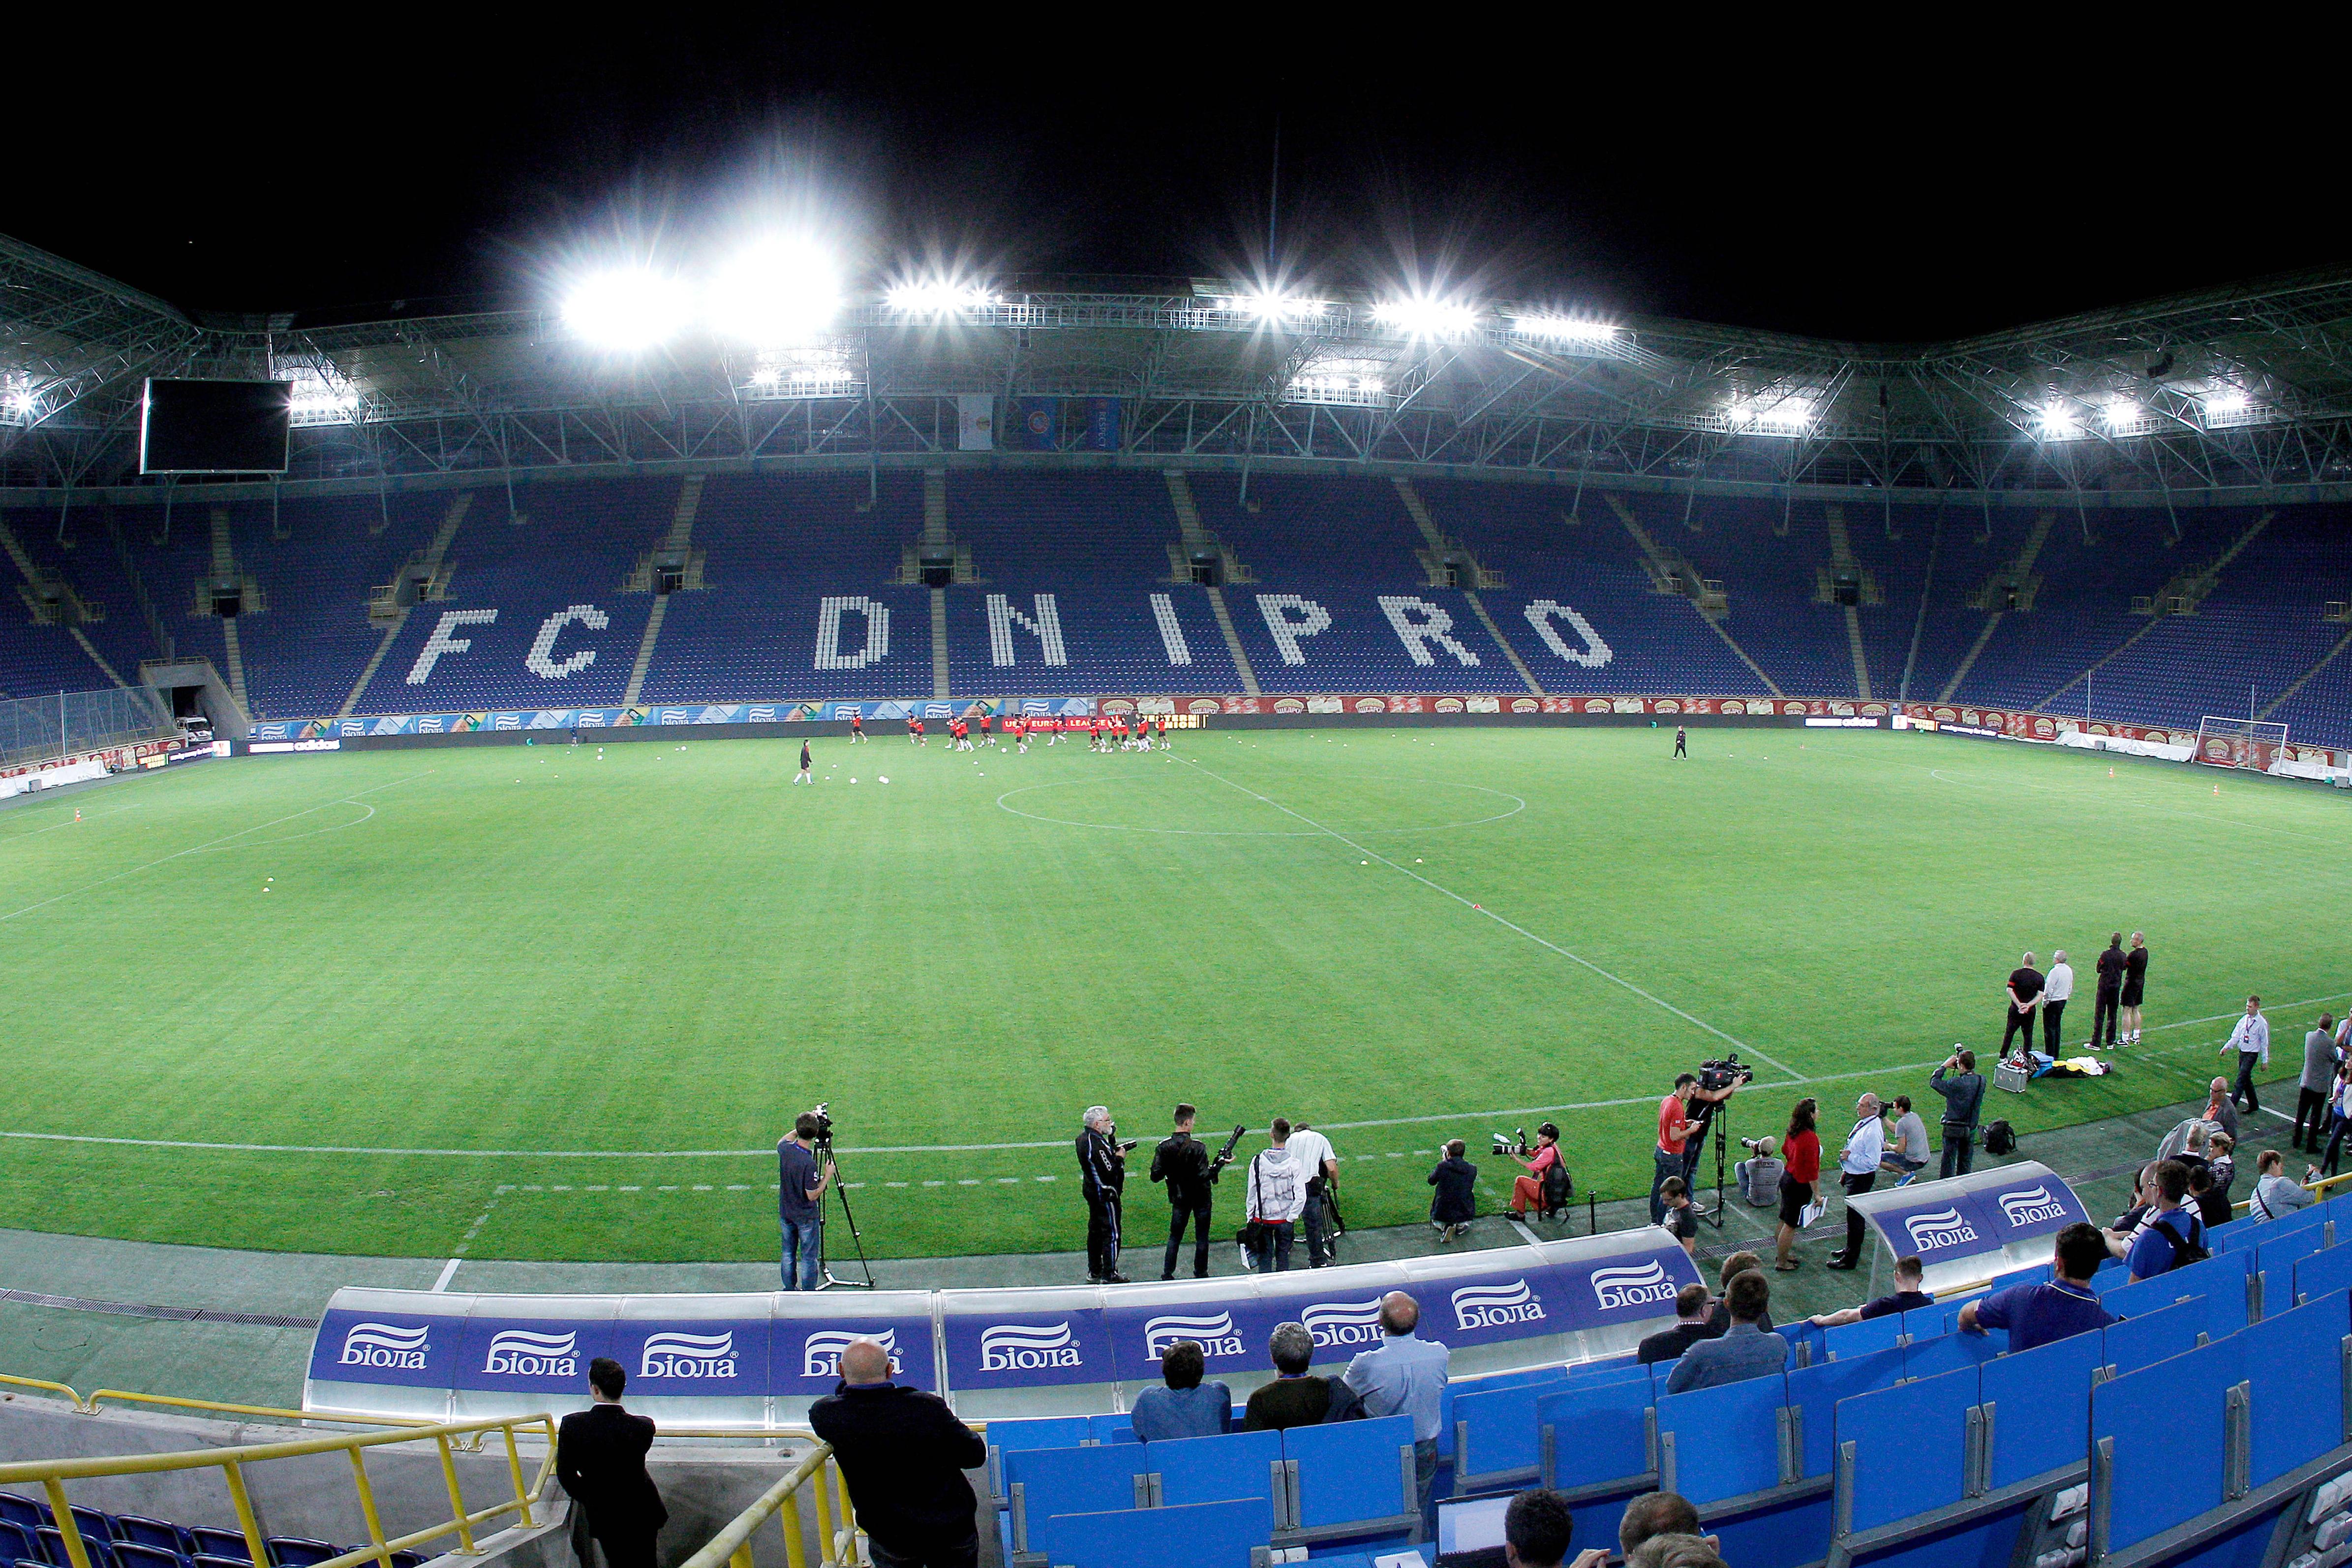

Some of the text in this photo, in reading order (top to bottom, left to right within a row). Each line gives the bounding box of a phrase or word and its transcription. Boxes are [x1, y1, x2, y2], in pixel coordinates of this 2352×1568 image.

[1099, 411, 1107, 448] RESPECT
[406, 594, 1613, 684] FC DNIPRO
[294, 739, 341, 751] adidas
[2006, 1193, 2066, 1228] Біола
[1911, 1217, 1979, 1253] Біола
[1456, 1291, 1547, 1331] Біола
[1596, 1273, 1678, 1311] Біола
[337, 1333, 428, 1370] Біола
[482, 1340, 578, 1376] Біола
[637, 1340, 738, 1378] Біола
[800, 1339, 904, 1377] Біа
[979, 1332, 1082, 1371] Біола
[1145, 1323, 1246, 1361] Бла
